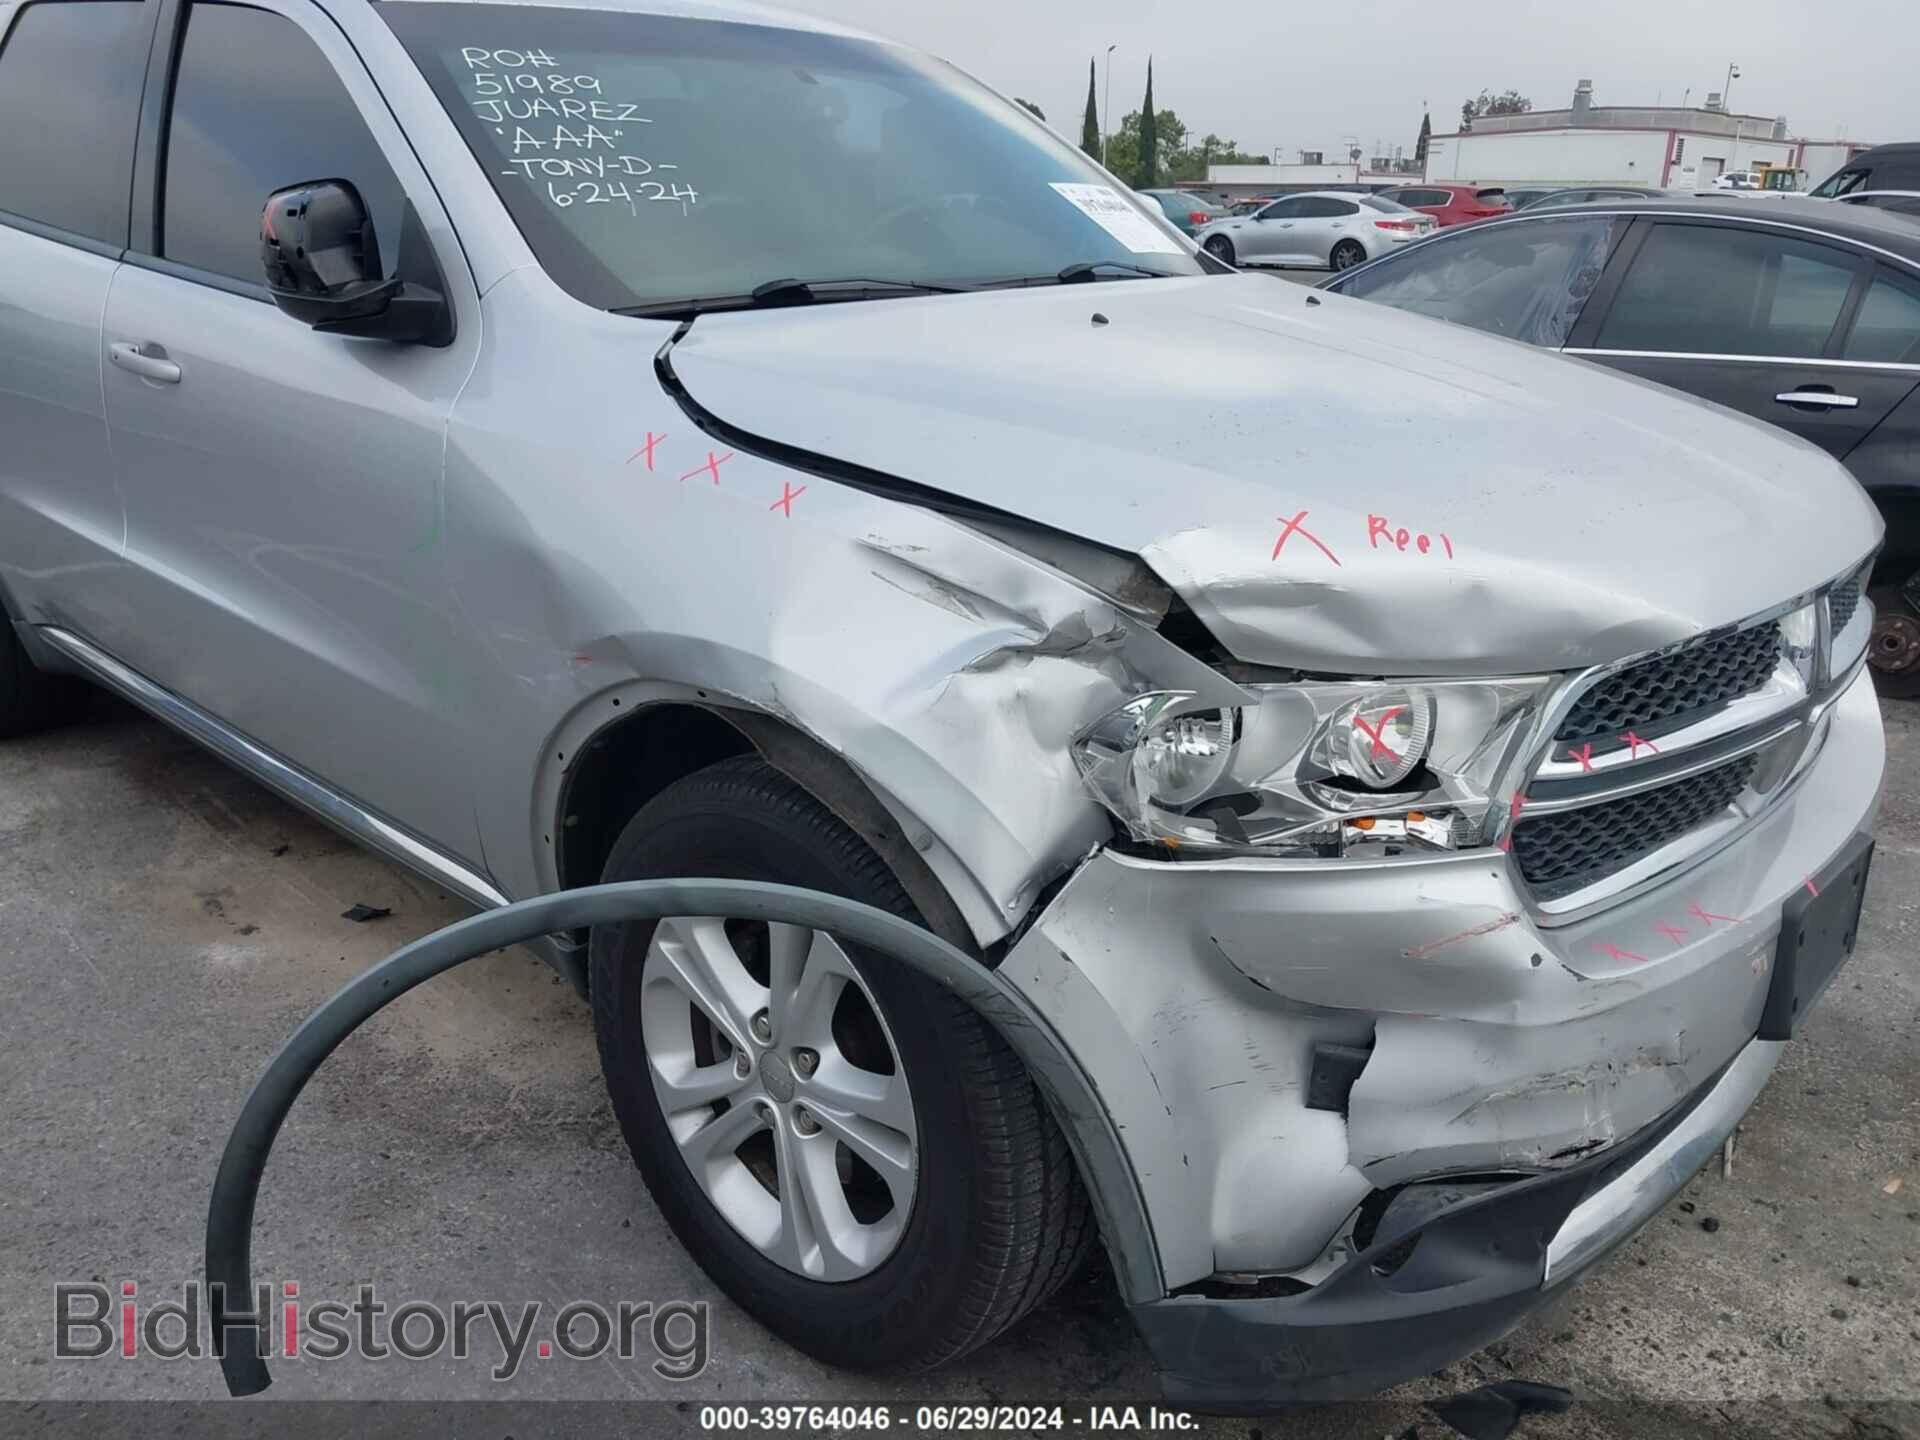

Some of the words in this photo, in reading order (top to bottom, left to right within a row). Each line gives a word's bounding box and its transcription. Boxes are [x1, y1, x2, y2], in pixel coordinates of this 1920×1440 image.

[461, 47, 560, 69] RO#
[475, 73, 602, 96] 51989
[473, 97, 653, 123] JUAREZ
[548, 182, 699, 208] 6-24-24
